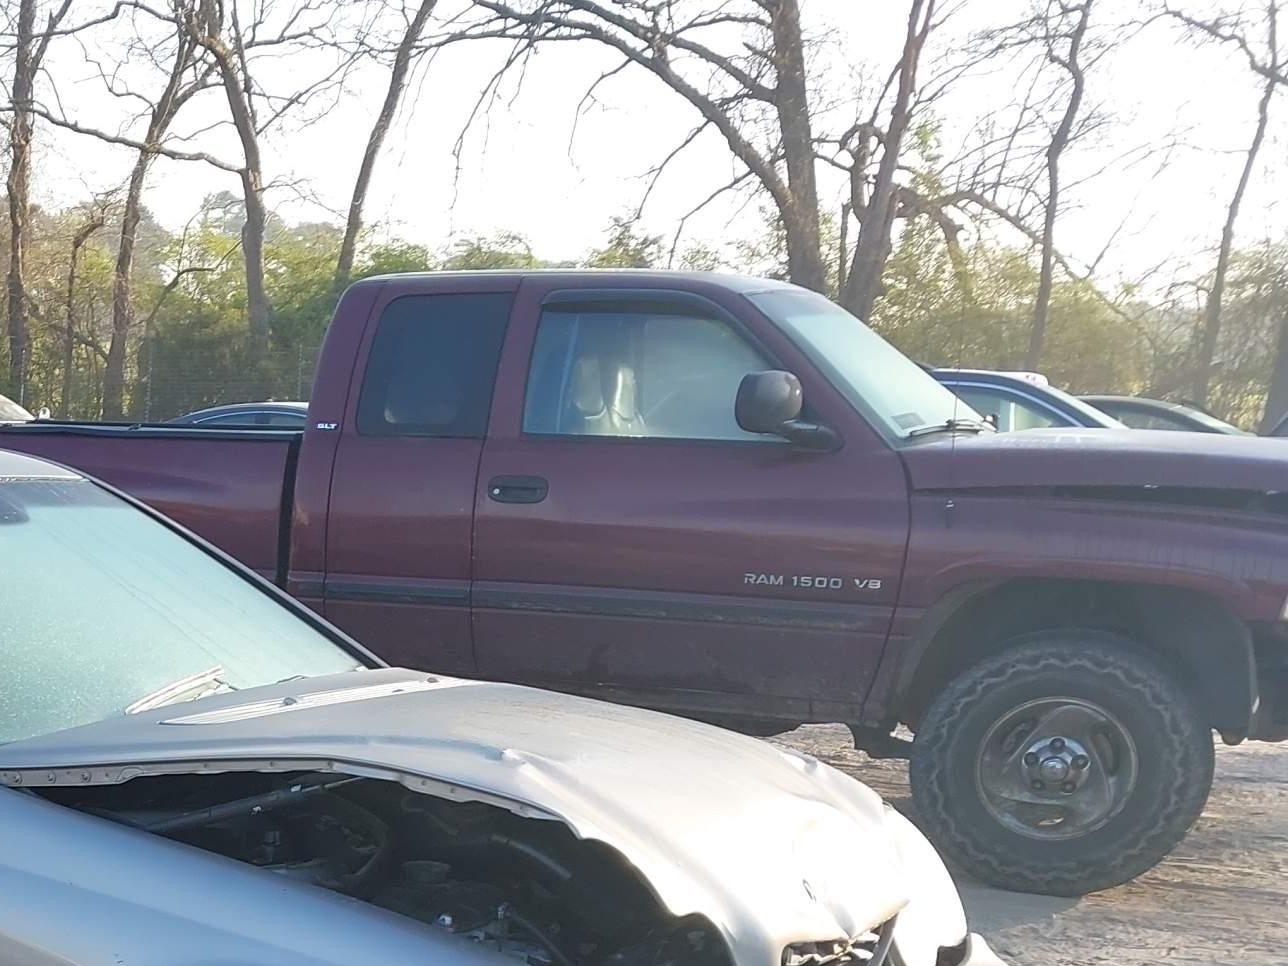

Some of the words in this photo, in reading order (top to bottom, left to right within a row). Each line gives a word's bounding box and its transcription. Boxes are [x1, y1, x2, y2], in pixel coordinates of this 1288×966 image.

[744, 573, 784, 586] RAM
[792, 575, 842, 589] 1500
[854, 578, 881, 590] V8
